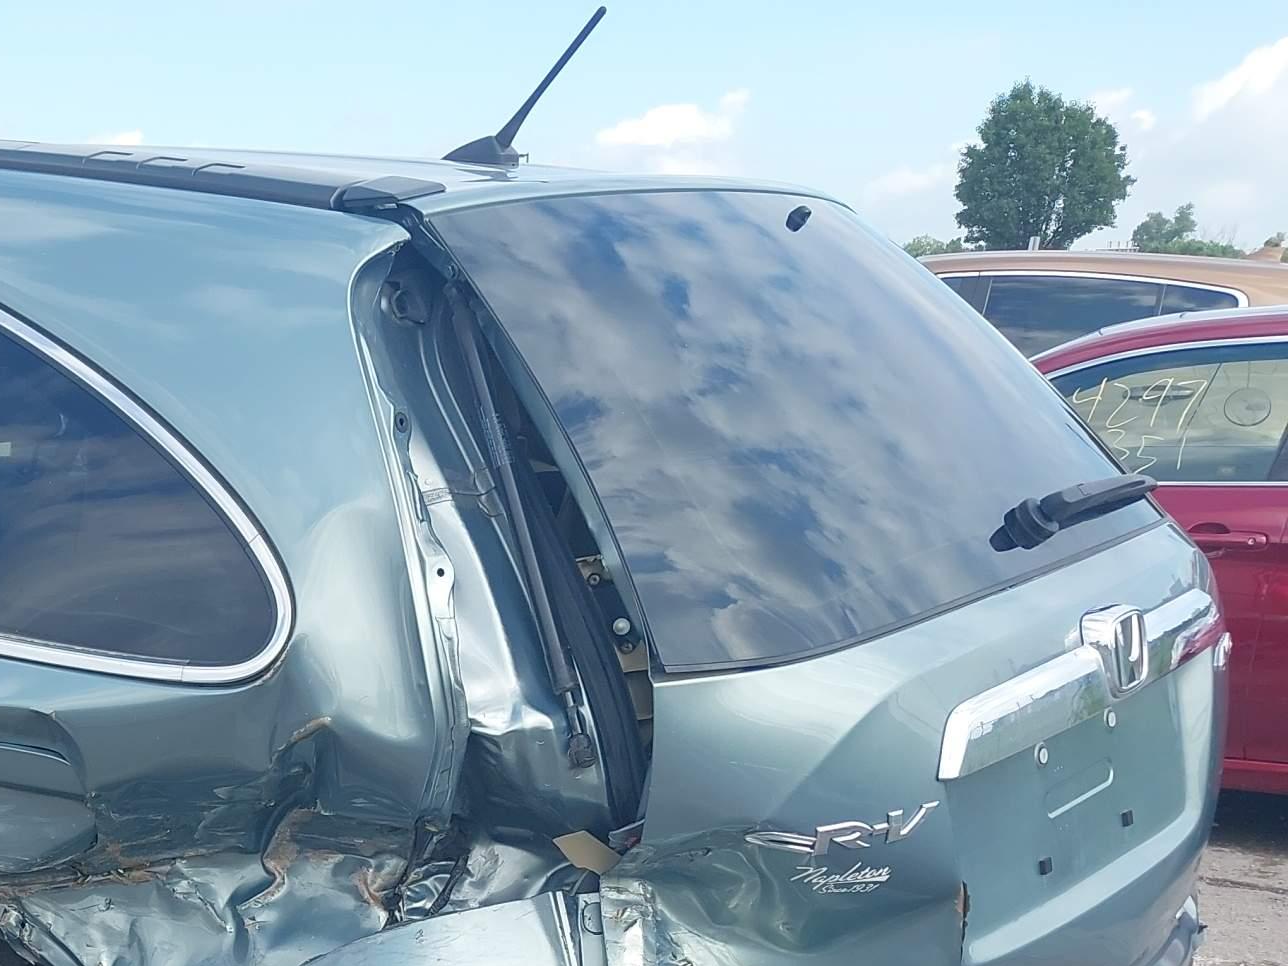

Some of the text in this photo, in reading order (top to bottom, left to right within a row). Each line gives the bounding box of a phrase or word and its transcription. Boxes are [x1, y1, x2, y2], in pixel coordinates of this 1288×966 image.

[1073, 377, 1208, 434] 4297
[744, 800, 940, 856] CR-V
[790, 861, 892, 891] Napleton
